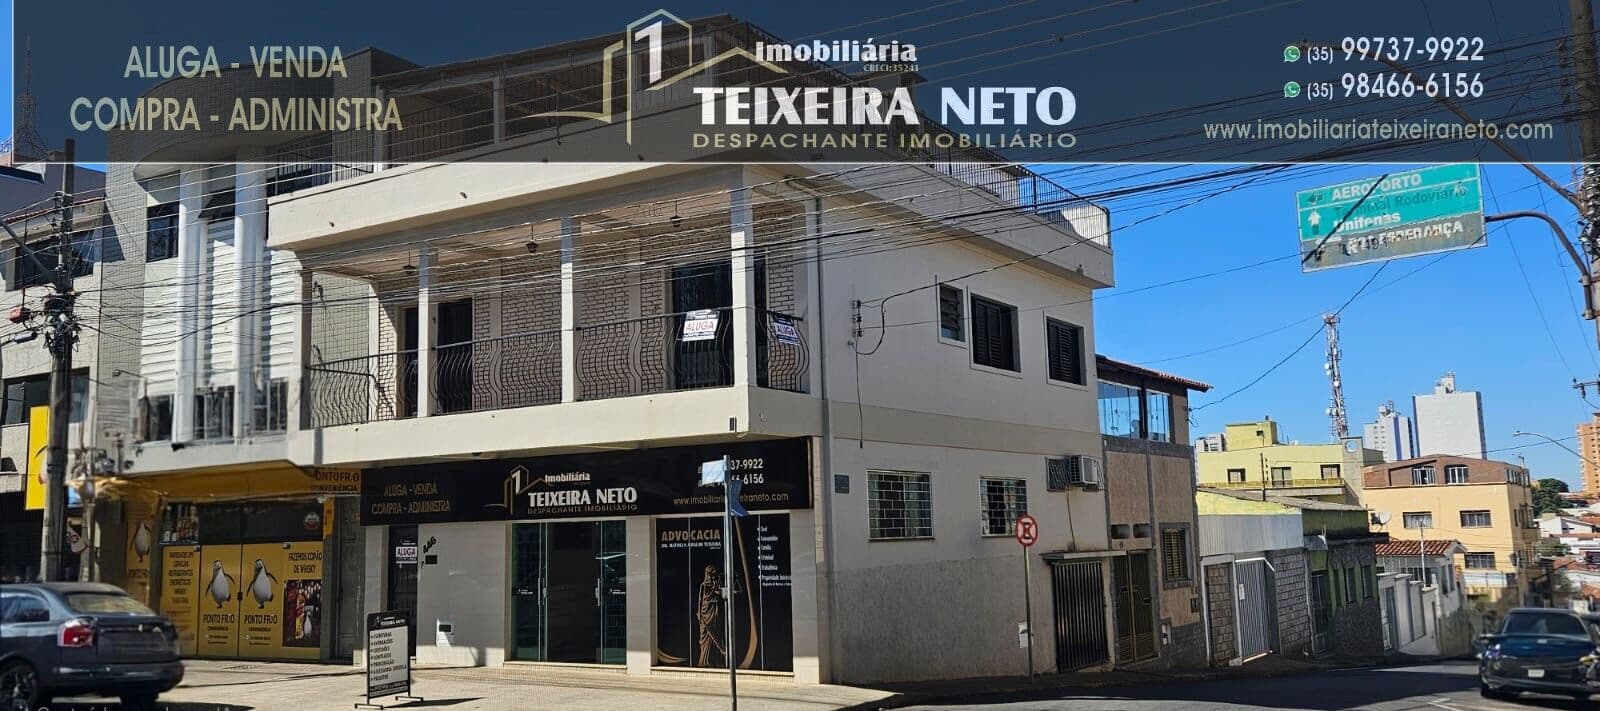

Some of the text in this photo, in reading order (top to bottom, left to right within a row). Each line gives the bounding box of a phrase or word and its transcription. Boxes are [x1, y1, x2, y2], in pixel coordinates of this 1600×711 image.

[1333, 212, 1401, 233] Unifenas
[686, 320, 714, 332] ALUGA
[315, 471, 339, 481] ONTO
[384, 482, 407, 497] ALUGA
[413, 481, 438, 496] VENDA
[527, 486, 637, 507] TEIXEIRA NETO
[371, 501, 401, 515] COMPRA
[408, 499, 451, 514] ADMINISTRA
[527, 506, 580, 515] DESPACHANTE
[661, 528, 721, 541] ADVOCACIA
[397, 547, 416, 556] ALUGA
[203, 614, 221, 624] PONTO
[244, 615, 263, 625] PONTO
